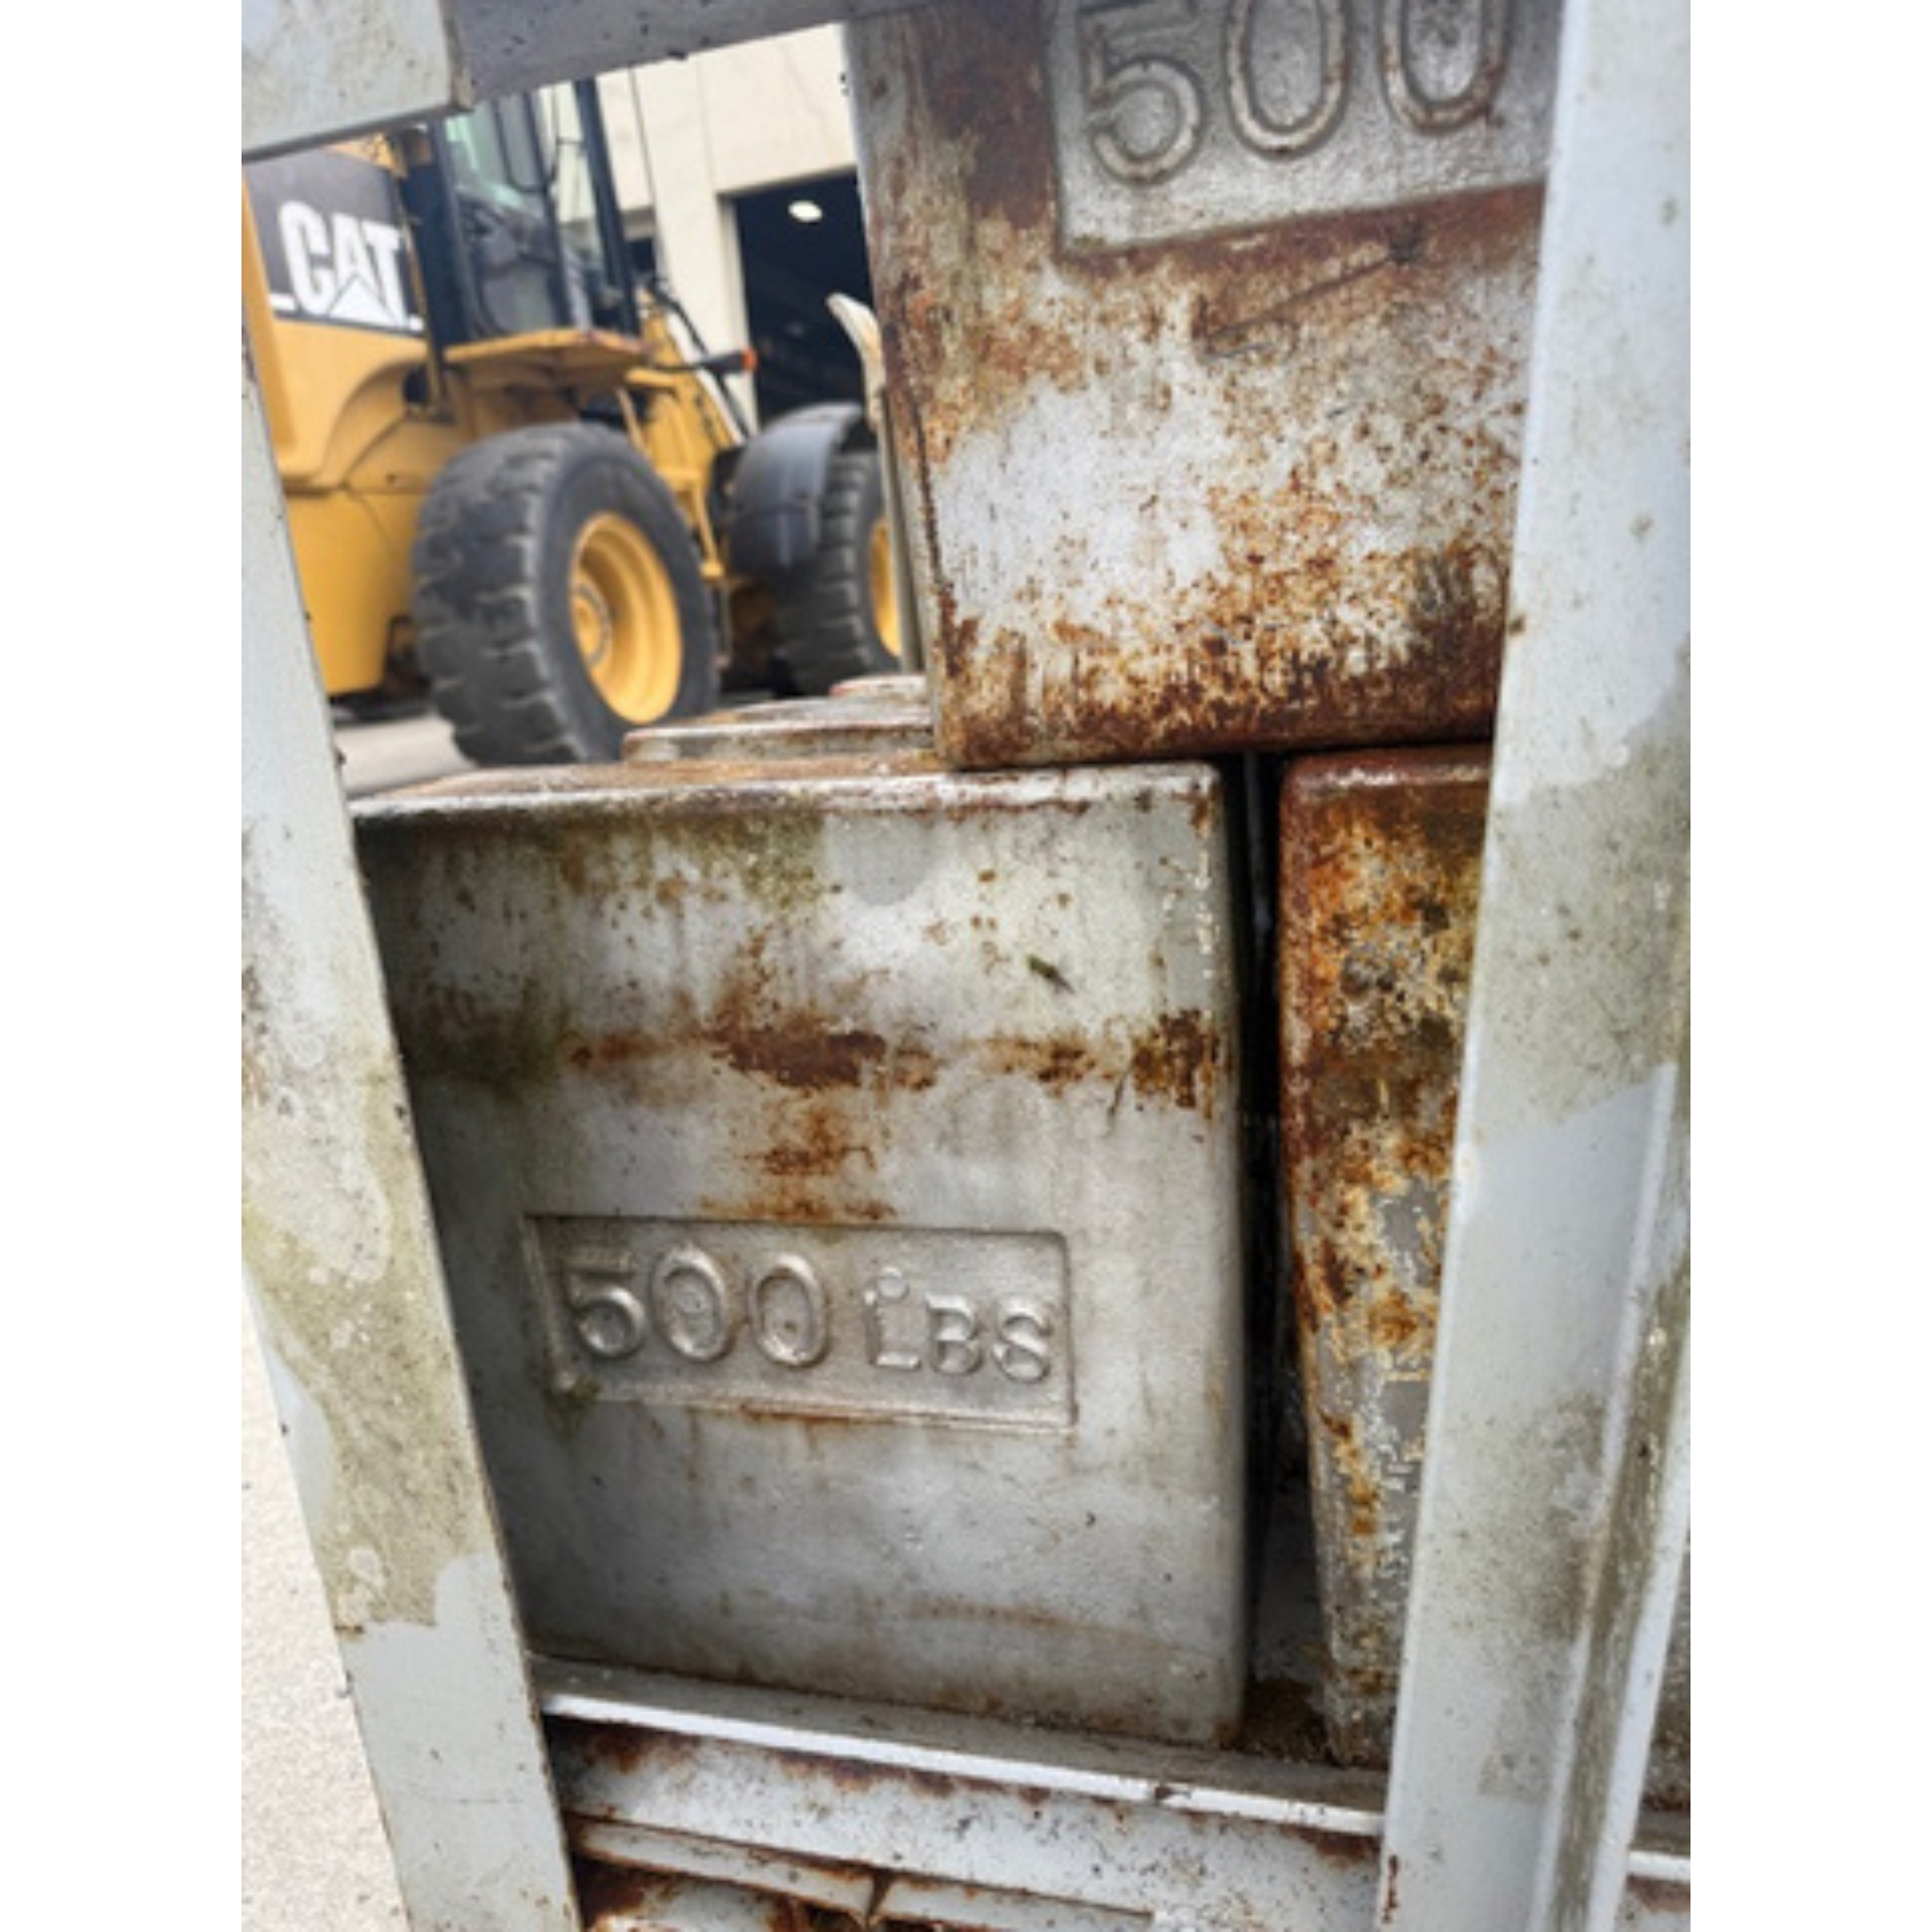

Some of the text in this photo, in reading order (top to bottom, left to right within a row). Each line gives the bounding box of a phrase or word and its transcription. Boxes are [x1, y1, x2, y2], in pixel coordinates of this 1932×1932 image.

[1075, 0, 1512, 183] 500
[279, 200, 408, 327] CAT
[563, 1243, 1051, 1383] 500 LBS
